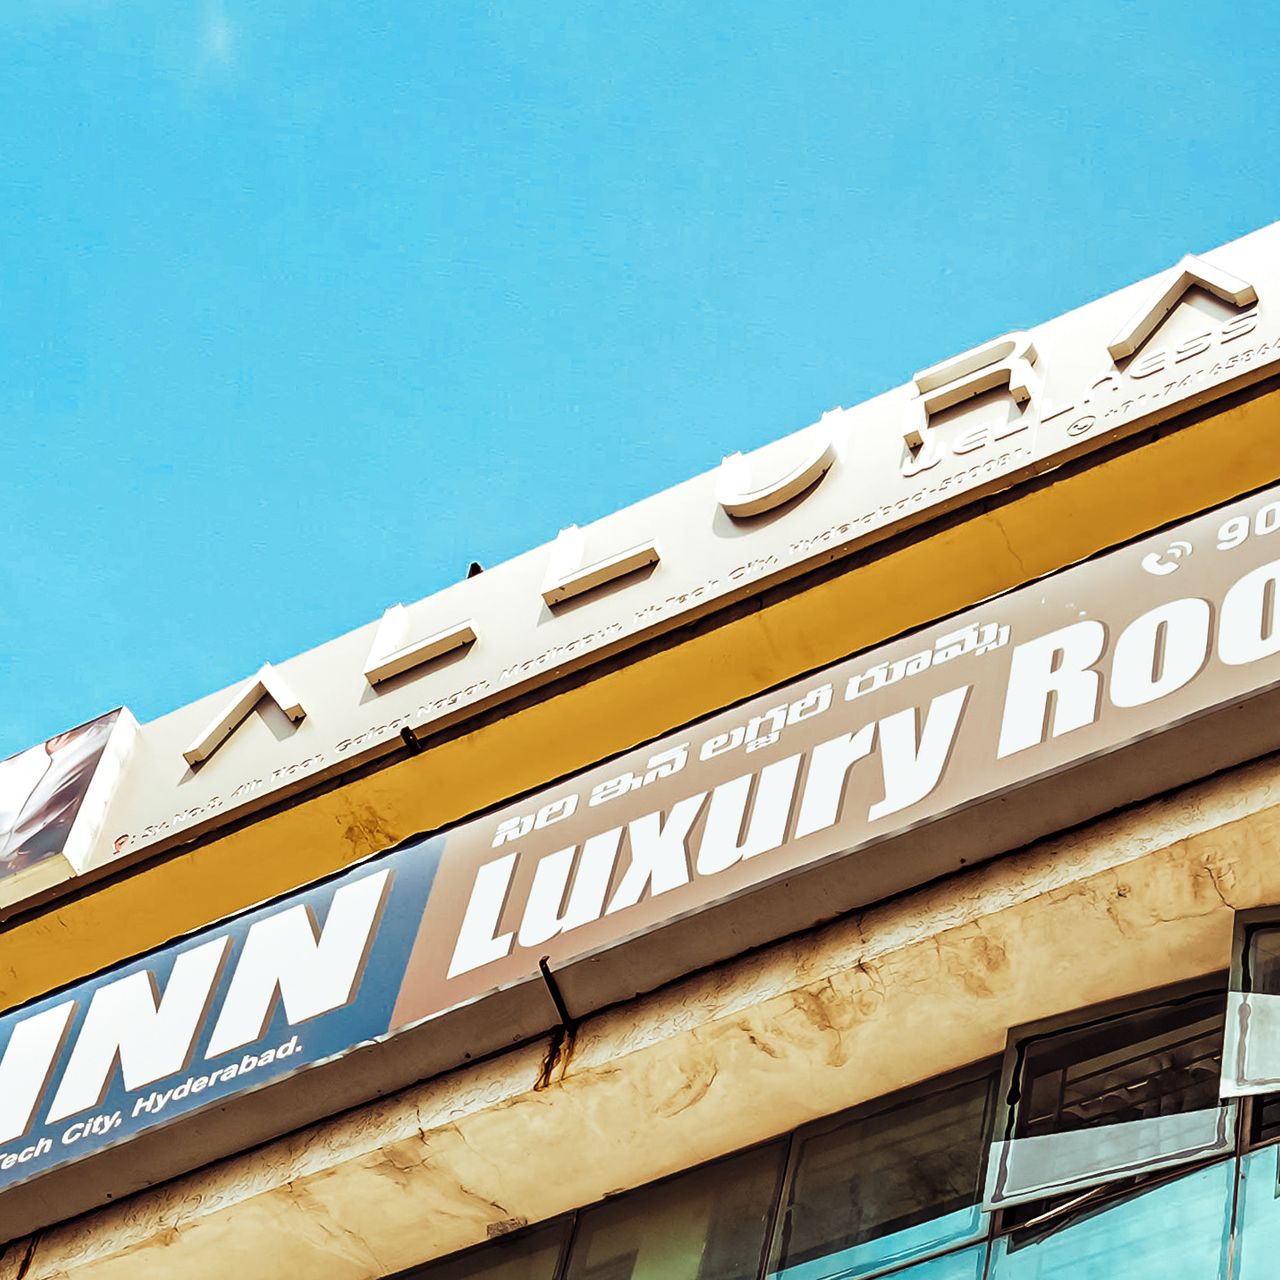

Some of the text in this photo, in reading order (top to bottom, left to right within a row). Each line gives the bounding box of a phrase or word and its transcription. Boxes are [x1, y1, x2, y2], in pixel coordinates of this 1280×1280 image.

[183, 254, 1259, 768] ALLURA
[333, 709, 413, 754] Gafoor
[449, 684, 970, 980] Luxury
[491, 792, 580, 848] సిరి
[61, 1110, 122, 1144] City,
[132, 1035, 303, 1118] Hyderabad.
